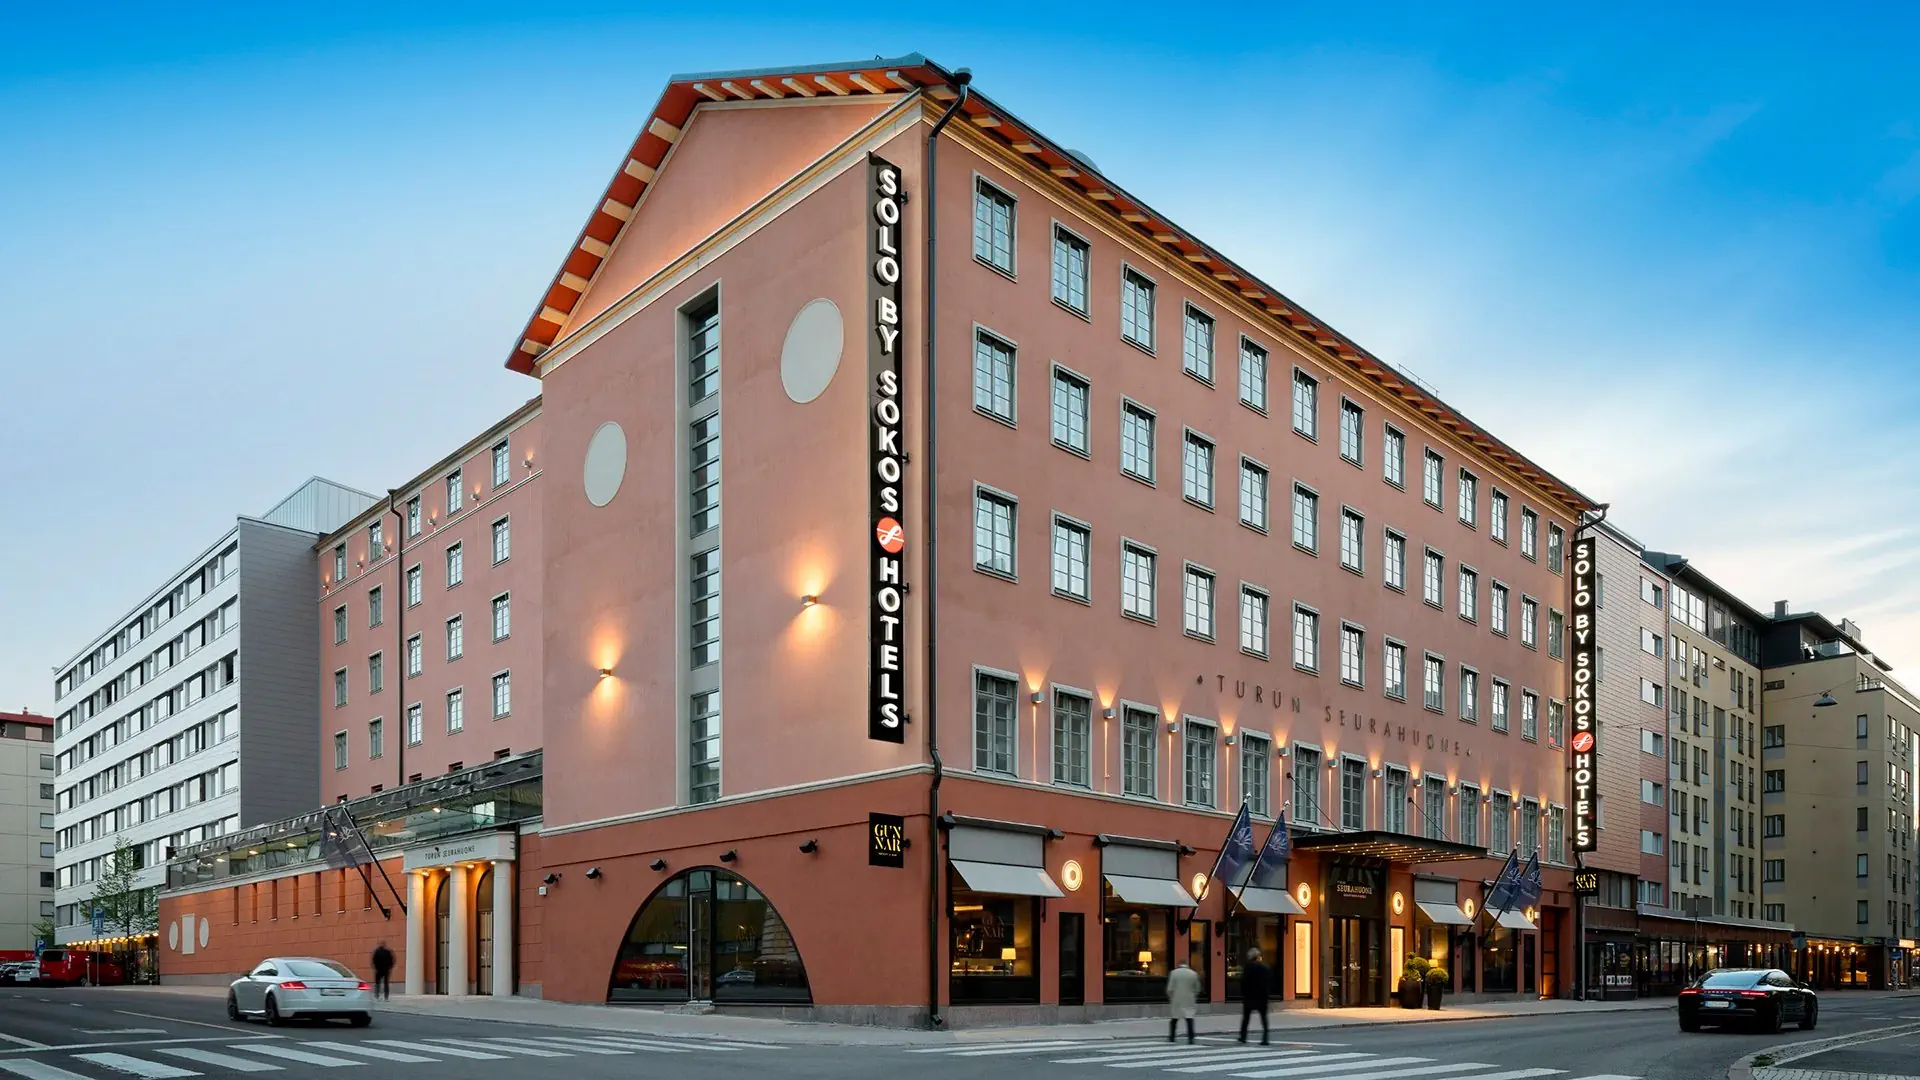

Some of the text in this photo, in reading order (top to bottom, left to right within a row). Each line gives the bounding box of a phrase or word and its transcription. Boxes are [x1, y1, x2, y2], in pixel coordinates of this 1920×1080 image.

[876, 168, 900, 728] SOLO BY SOKOS HOTELS
[1574, 544, 1591, 846] SOLO BY SOKOS HOTELS
[1216, 674, 1461, 756] TURUN SEURAHUONE
[874, 823, 901, 839] GUN
[875, 836, 901, 852] NAR
[1576, 873, 1596, 881] GUN
[1577, 880, 1596, 888] NAR
